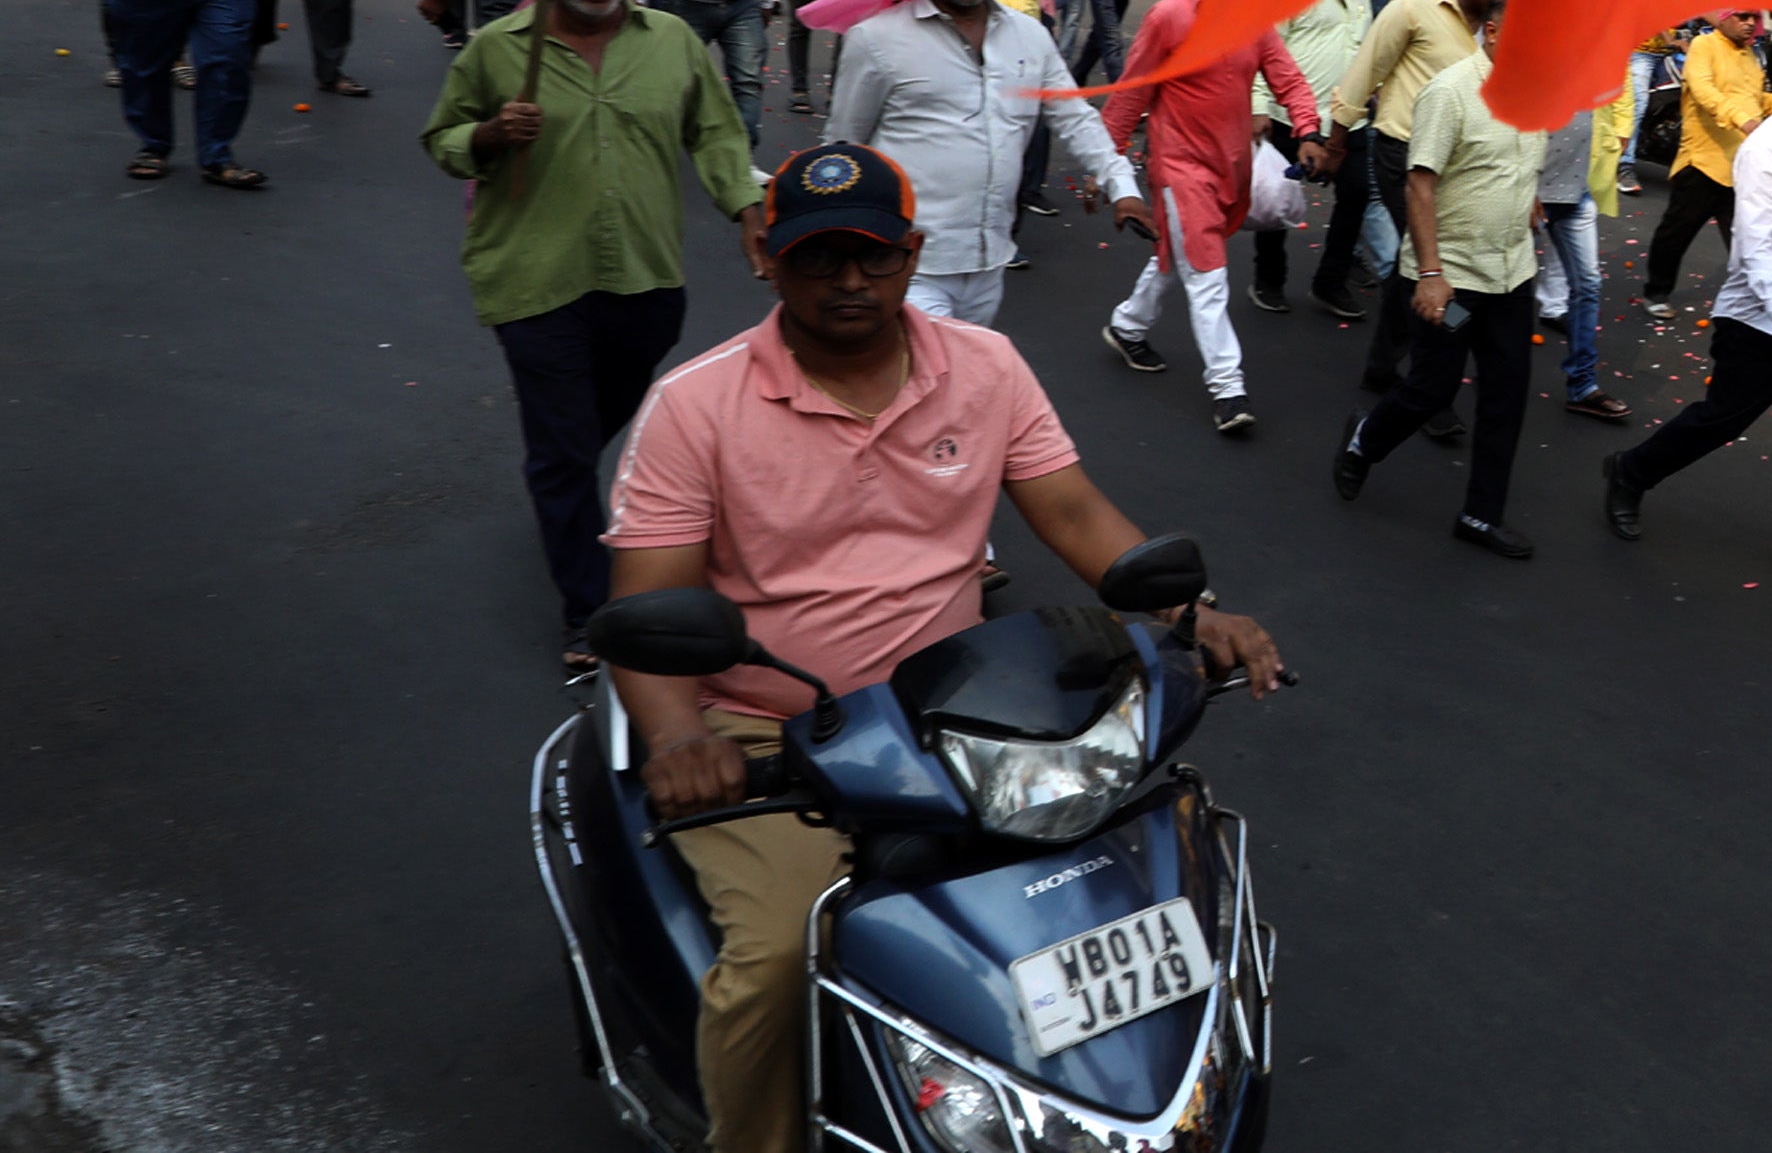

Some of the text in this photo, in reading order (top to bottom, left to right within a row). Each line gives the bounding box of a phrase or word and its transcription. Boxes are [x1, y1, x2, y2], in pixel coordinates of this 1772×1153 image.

[1023, 855, 1114, 899] HONDA
[1055, 911, 1180, 991] WB01A
[1079, 953, 1193, 1031] J4749
